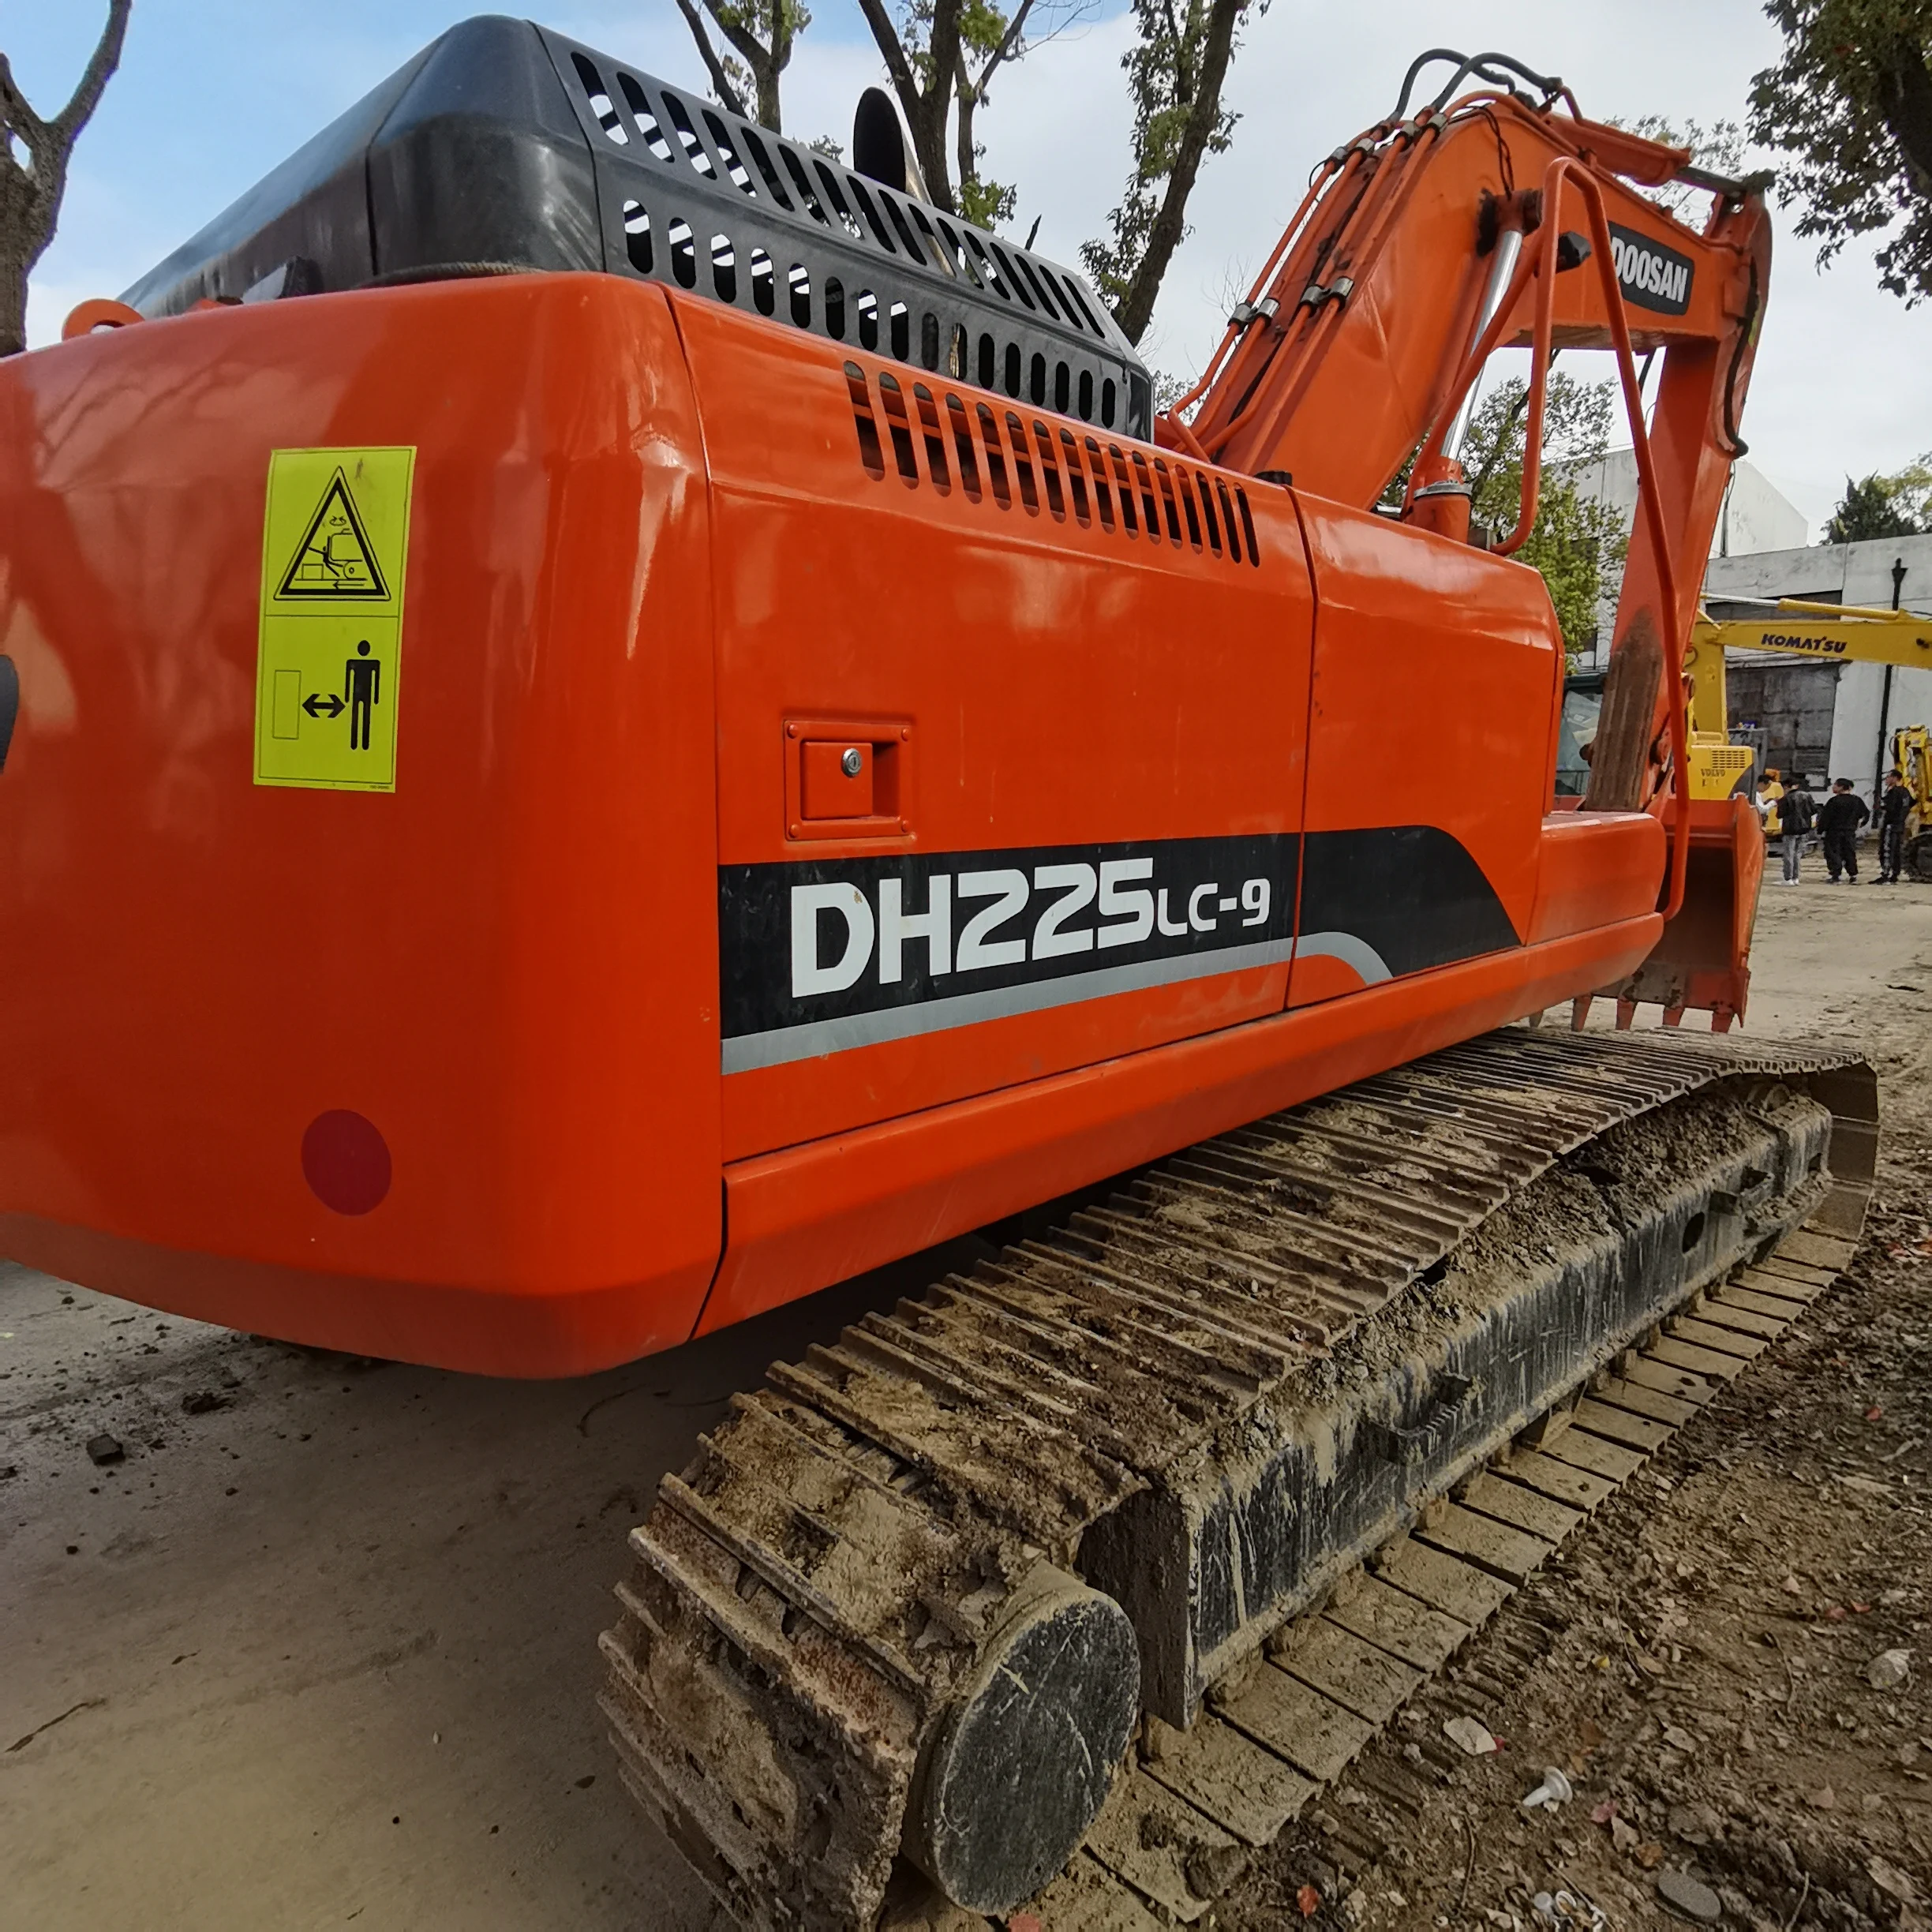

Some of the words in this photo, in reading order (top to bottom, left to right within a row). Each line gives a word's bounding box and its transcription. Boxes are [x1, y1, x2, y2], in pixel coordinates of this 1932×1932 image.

[1611, 237, 1688, 303] DOOSAN
[1761, 634, 1848, 653] KOMATSU
[791, 857, 1271, 998] DH225LC-9
